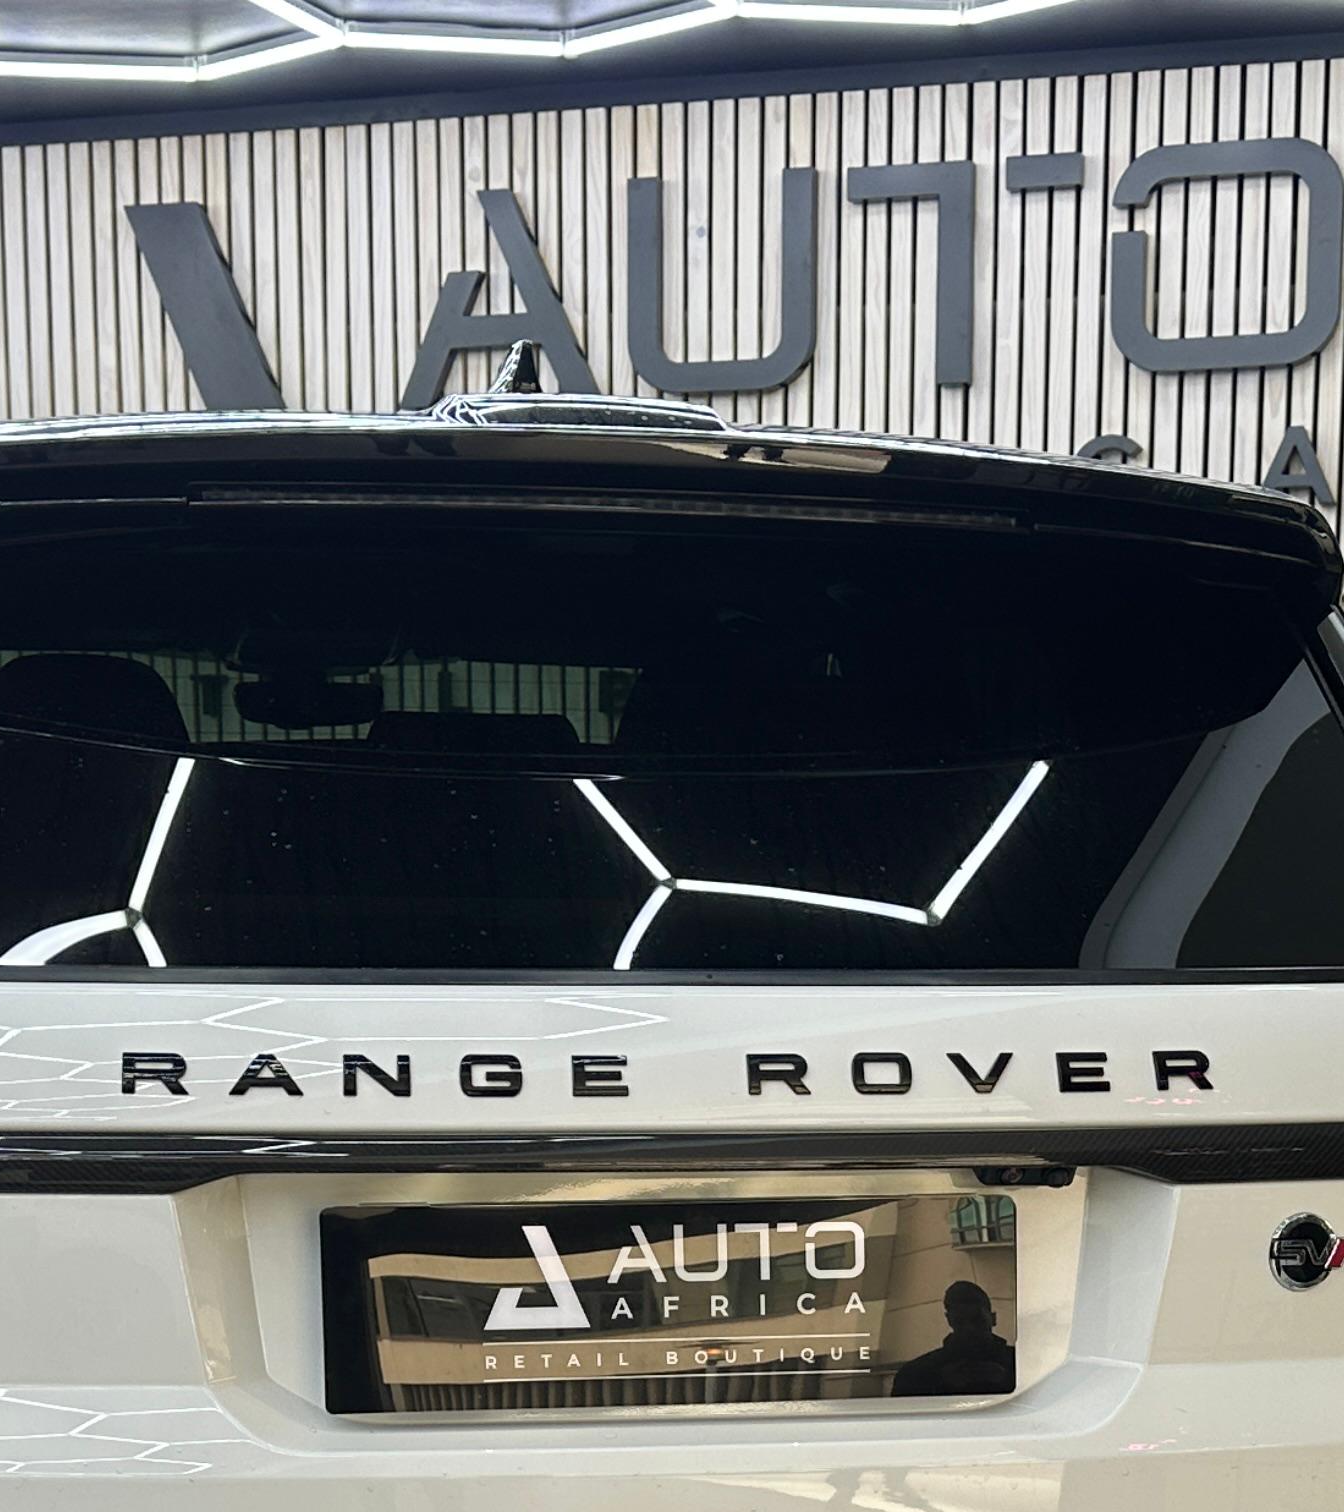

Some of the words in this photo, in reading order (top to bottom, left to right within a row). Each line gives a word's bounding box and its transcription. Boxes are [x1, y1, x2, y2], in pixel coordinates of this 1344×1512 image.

[400, 137, 1344, 410] AUTO
[120, 1051, 630, 1098] RANGE
[746, 1048, 1217, 1096] ROVER
[607, 1220, 867, 1285] AUTO
[610, 1291, 867, 1320] AFRICA
[484, 1352, 631, 1371] RETAIL
[666, 1344, 872, 1367] BOUTIQUE
